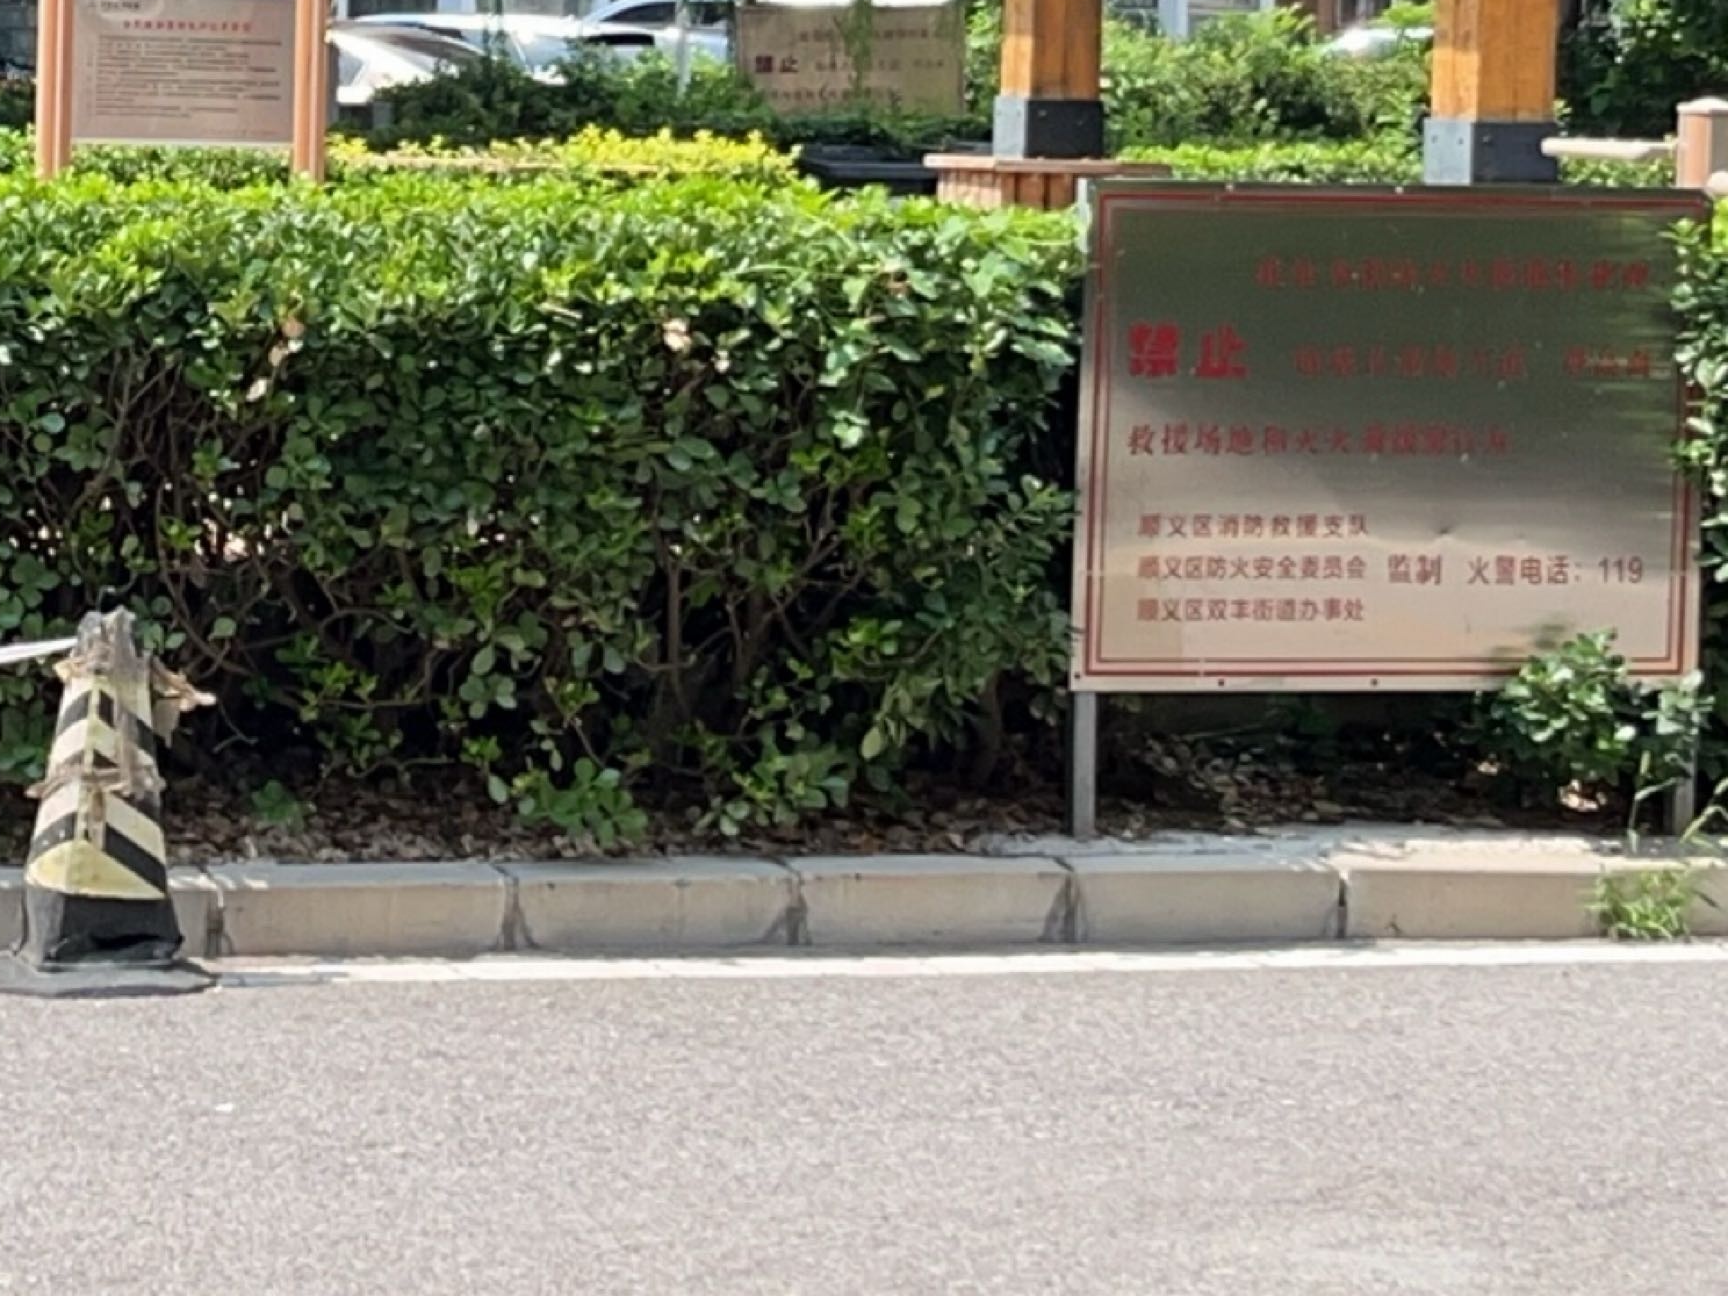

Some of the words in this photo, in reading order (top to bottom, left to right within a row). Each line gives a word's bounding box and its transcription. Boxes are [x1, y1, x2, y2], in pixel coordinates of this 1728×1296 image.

[1129, 322, 1248, 379] 禁止
[1138, 513, 1369, 538] 顺义区消防救援支队
[1137, 555, 1368, 580] 顺义区防火安全委员会
[1387, 553, 1442, 586] 监制
[1137, 598, 1364, 622] 顺义区双丰街道办事处
